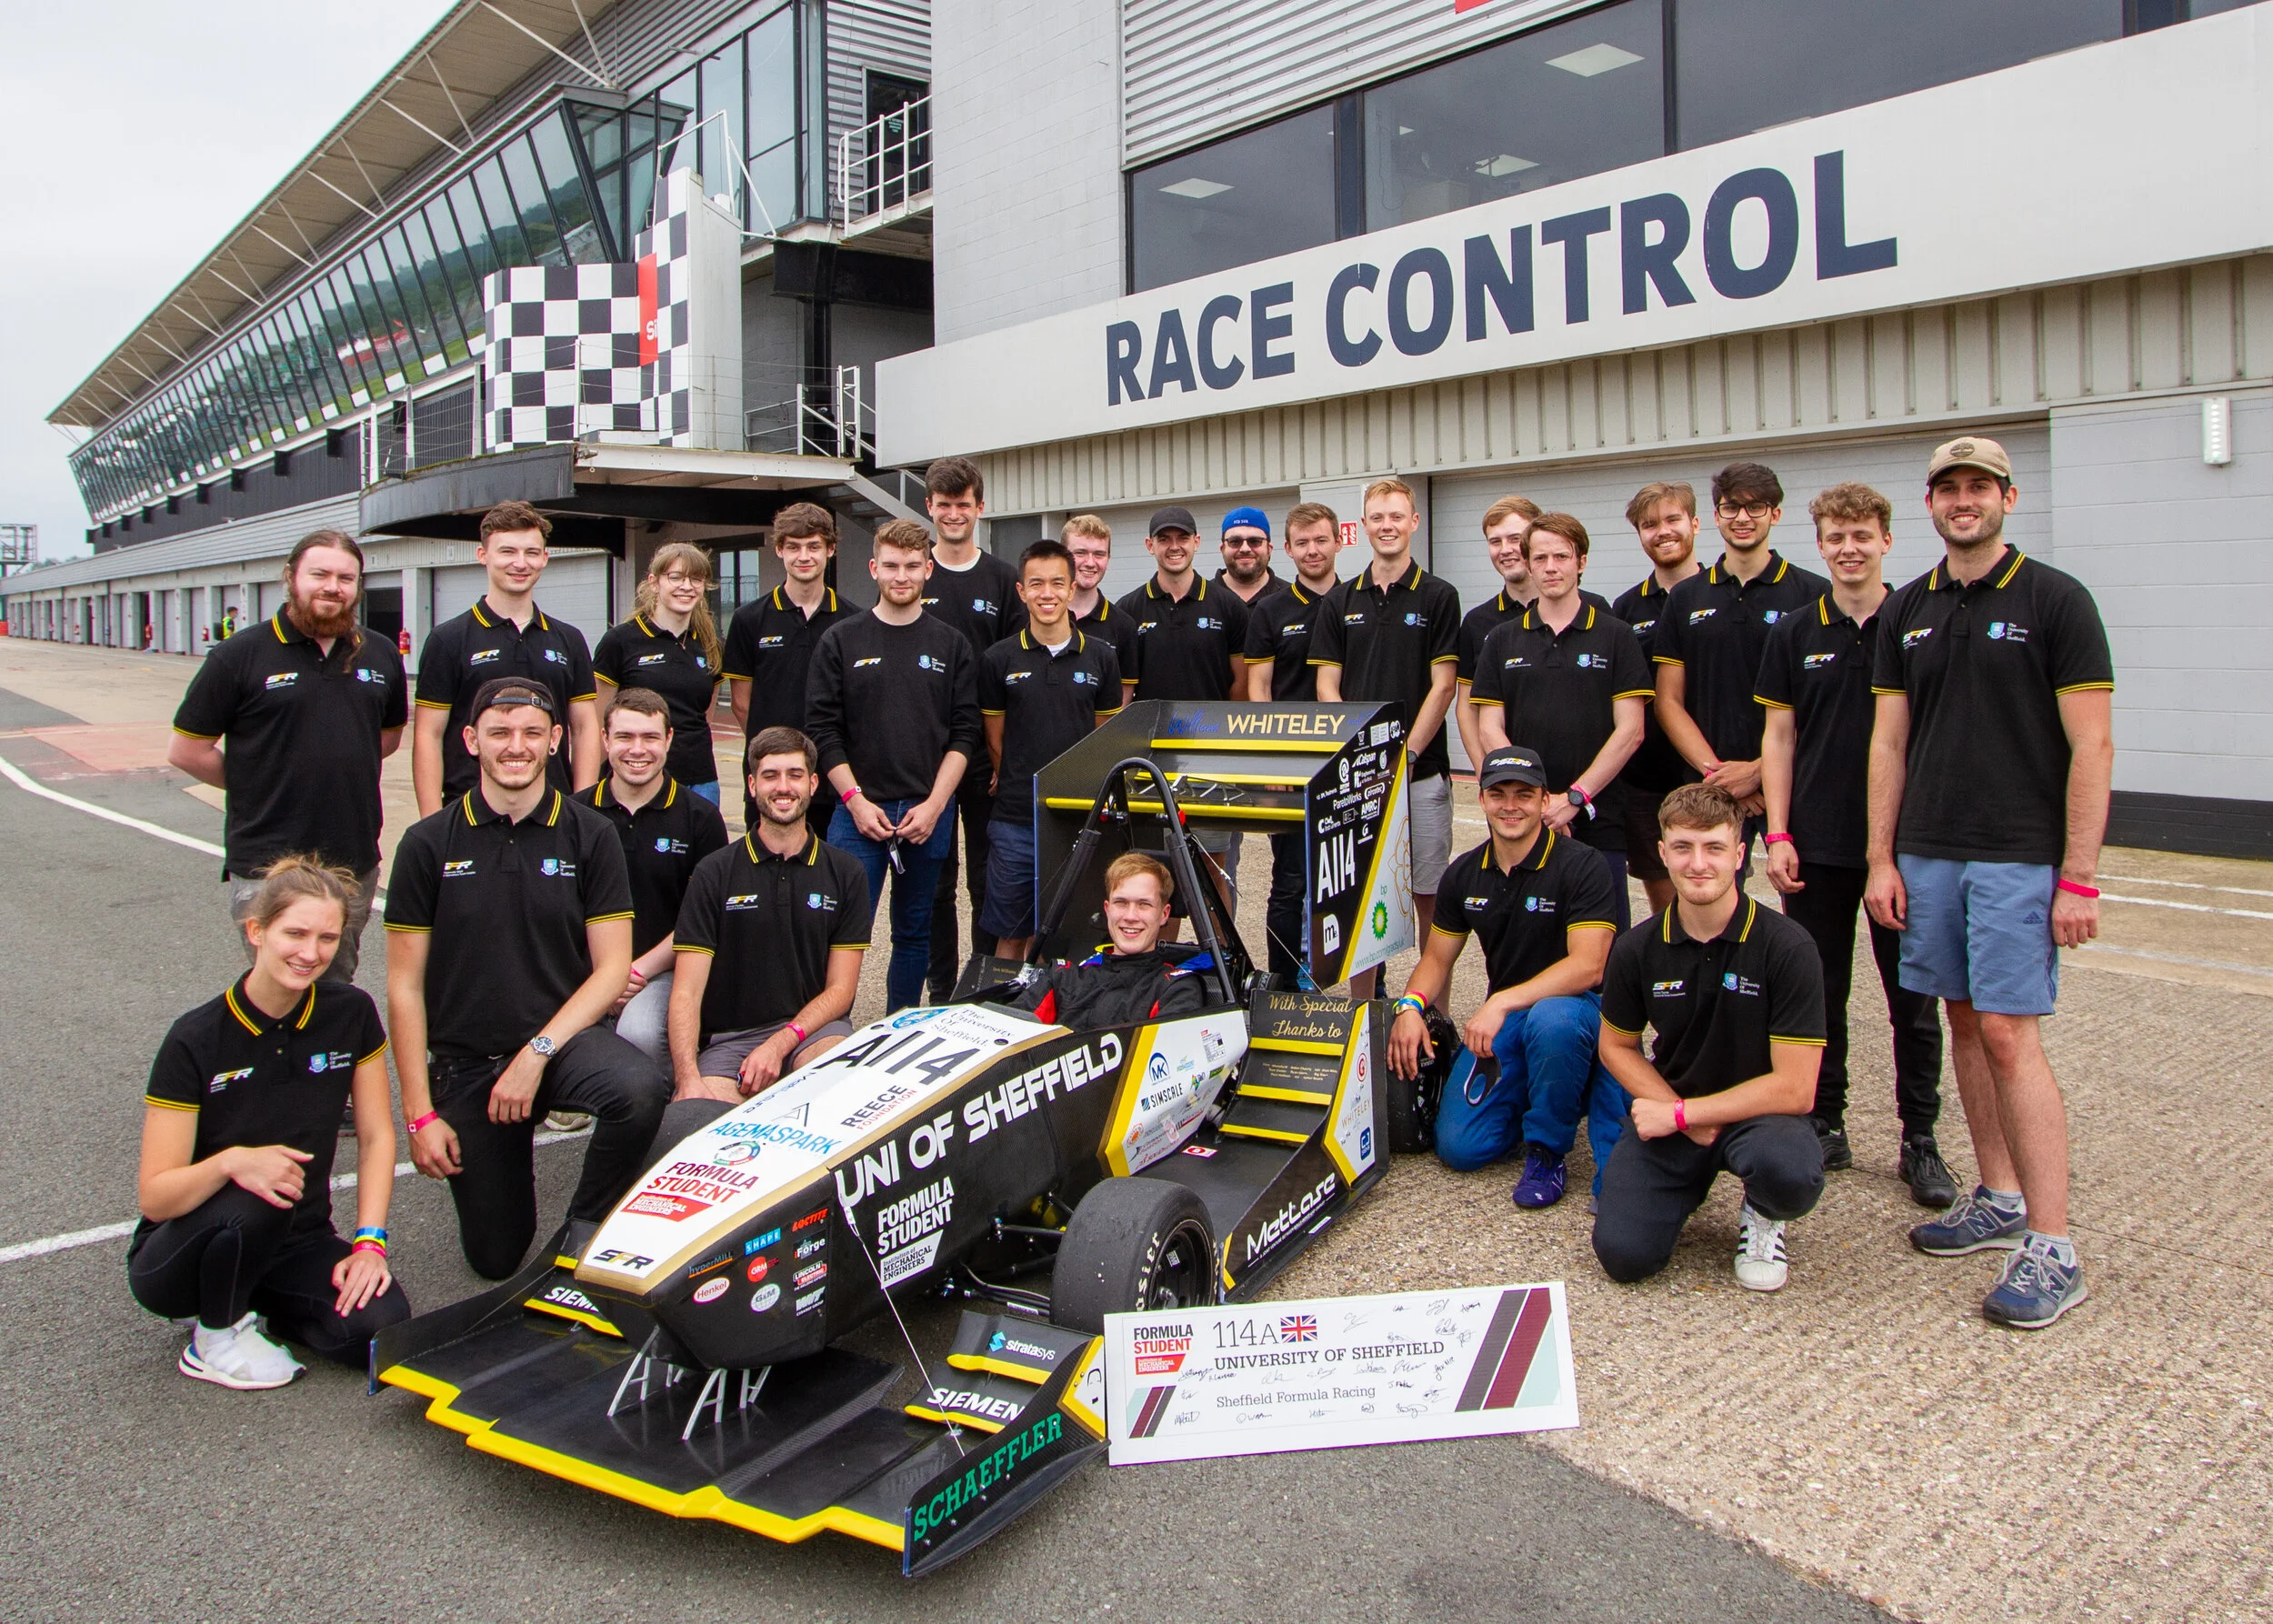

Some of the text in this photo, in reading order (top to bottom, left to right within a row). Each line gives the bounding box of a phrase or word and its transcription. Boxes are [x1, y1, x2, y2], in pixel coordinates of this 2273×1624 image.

[1106, 149, 1898, 406] RACE CONTROL
[1227, 714, 1346, 735] WHITELEY
[1361, 799, 1377, 816] AMRC
[1380, 884, 1387, 897] bp
[1652, 980, 1683, 990] SFR
[962, 1007, 986, 1019] The
[1268, 994, 1352, 1018] With Special
[951, 1012, 1015, 1038] University
[1272, 1020, 1343, 1038] Thanks to
[211, 1067, 254, 1086] SFR
[1152, 1061, 1167, 1081] MK
[840, 1085, 908, 1128] REECE
[1150, 1082, 1183, 1108] SIMSCALE
[834, 1139, 900, 1209] UNI
[909, 1110, 955, 1170] OF
[964, 1032, 1123, 1144] SHEFFIELD
[857, 1089, 917, 1131] FOUNDATION
[1341, 1098, 1371, 1128] WHITELEY
[707, 1121, 842, 1155] AGEMASPARK
[666, 1161, 759, 1189] FORMULA
[646, 1176, 741, 1204] STUDENT
[877, 1176, 955, 1233] FORMULA
[791, 1208, 828, 1232] LOCTITE
[877, 1198, 953, 1255] STUDENT
[746, 1231, 780, 1252] SHAPE
[794, 1238, 826, 1259] iForge
[593, 1248, 655, 1269] SFR
[688, 1251, 733, 1276] hyperMILL
[751, 1262, 768, 1275] GRM
[795, 1261, 823, 1280] LINCOLN
[884, 1245, 932, 1274] MECHANICAL
[884, 1256, 926, 1281] ENGINEERS
[696, 1280, 728, 1299] Henkel
[1134, 1324, 1194, 1340] FORMULA
[1213, 1318, 1280, 1348] 114A
[1006, 1338, 1056, 1361] stratasys
[1134, 1338, 1192, 1354] STUDENT
[1214, 1350, 1319, 1371] UNIVERSITY
[1324, 1348, 1347, 1362] OF
[1351, 1340, 1445, 1360] SHEFFIELD
[1217, 1386, 1376, 1408] Sheffield Formula Racing
[913, 1412, 1063, 1542] SCHAEFFLER
